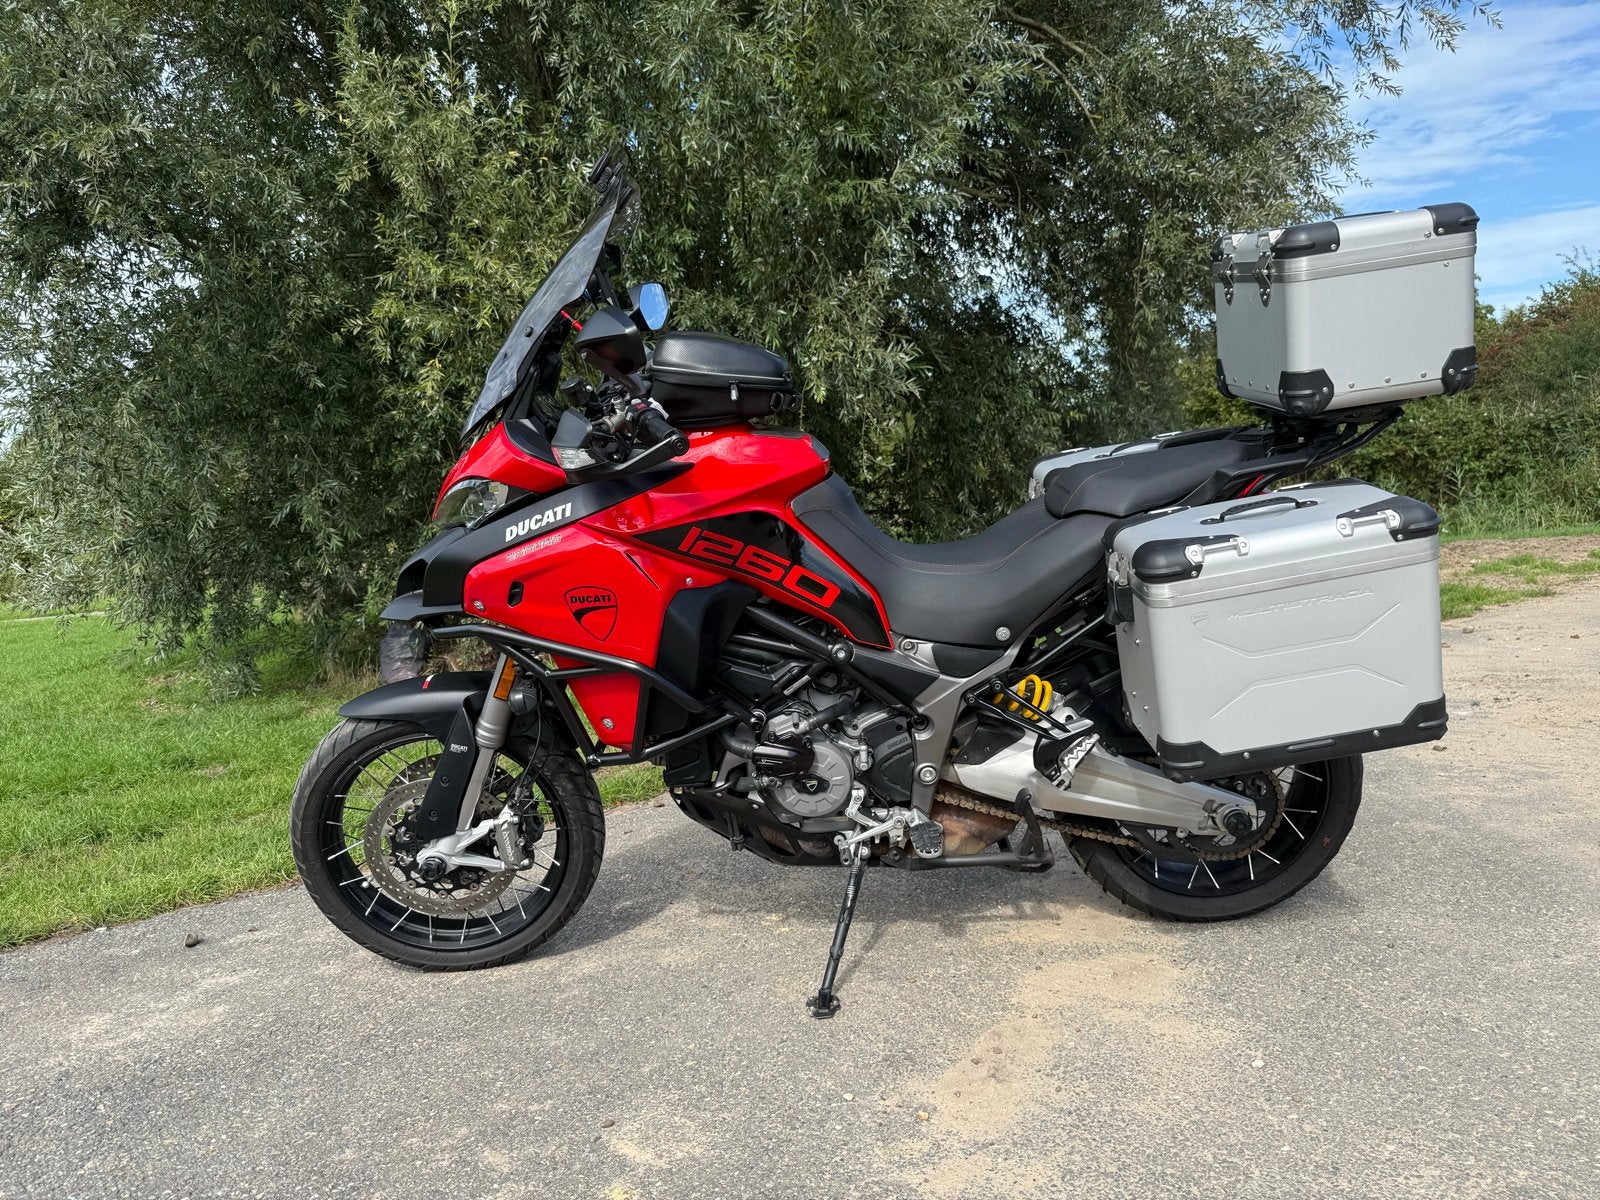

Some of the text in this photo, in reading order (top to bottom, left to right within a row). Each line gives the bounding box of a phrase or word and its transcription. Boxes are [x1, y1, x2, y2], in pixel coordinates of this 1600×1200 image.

[505, 502, 572, 543] DUCATI
[677, 527, 841, 609] 1260
[570, 595, 611, 604] DUCATI
